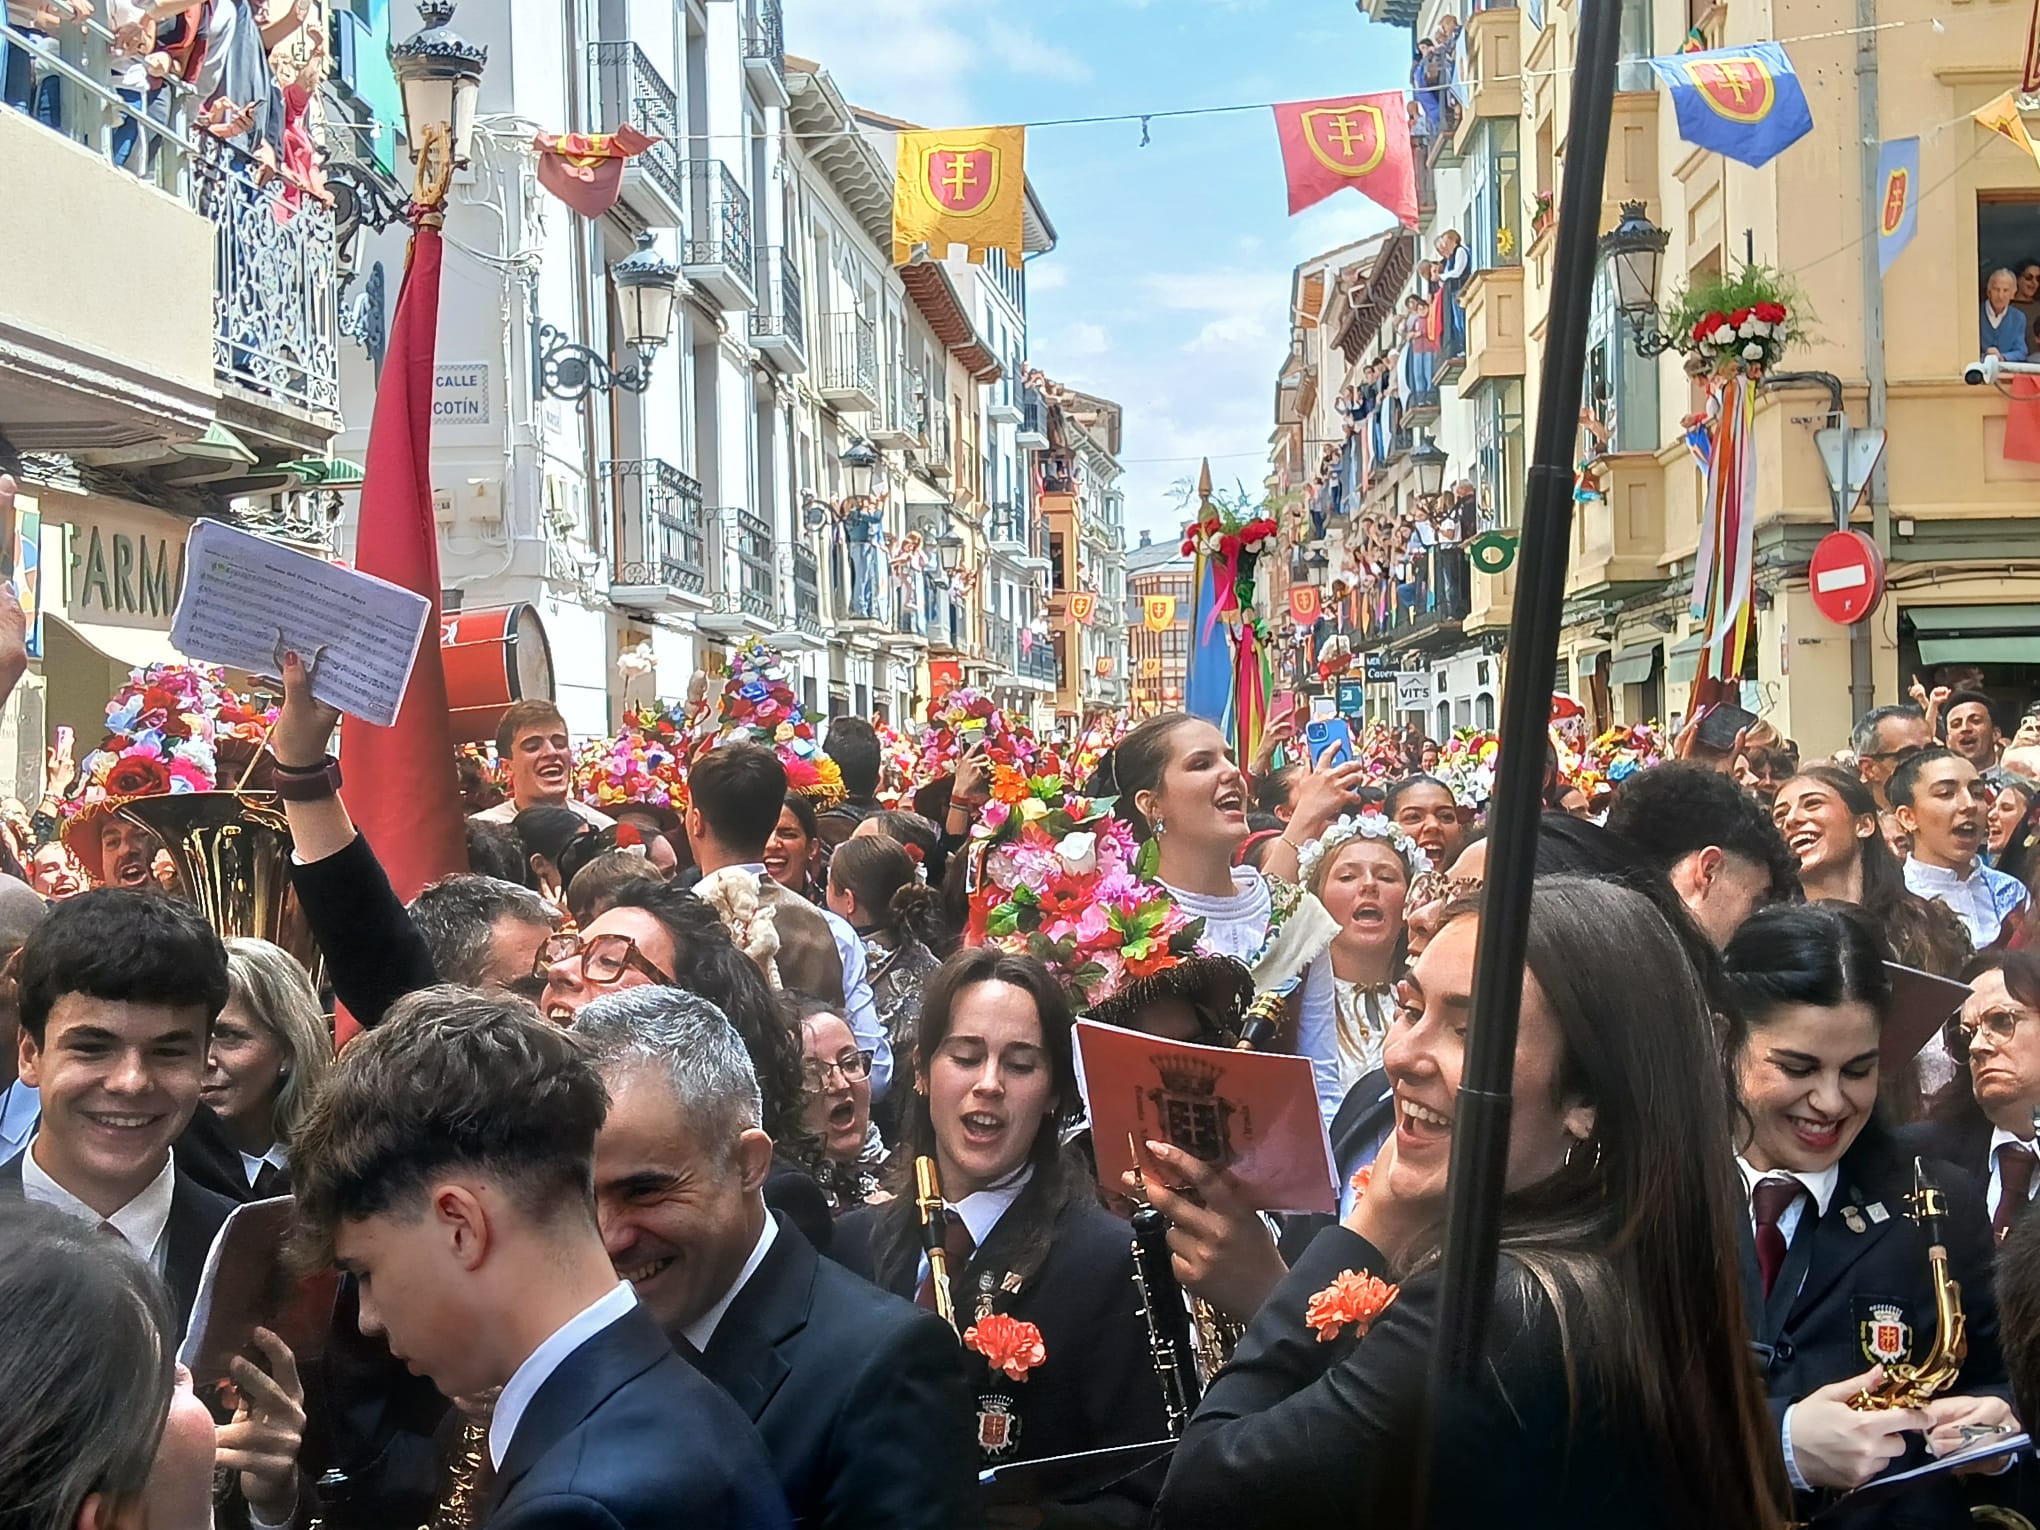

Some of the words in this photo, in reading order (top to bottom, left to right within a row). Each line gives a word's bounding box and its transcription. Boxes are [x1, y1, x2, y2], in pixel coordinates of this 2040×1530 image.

[435, 375, 478, 388] CALLE
[432, 396, 479, 415] COTÍN
[1400, 687, 1430, 698] VIT'S
